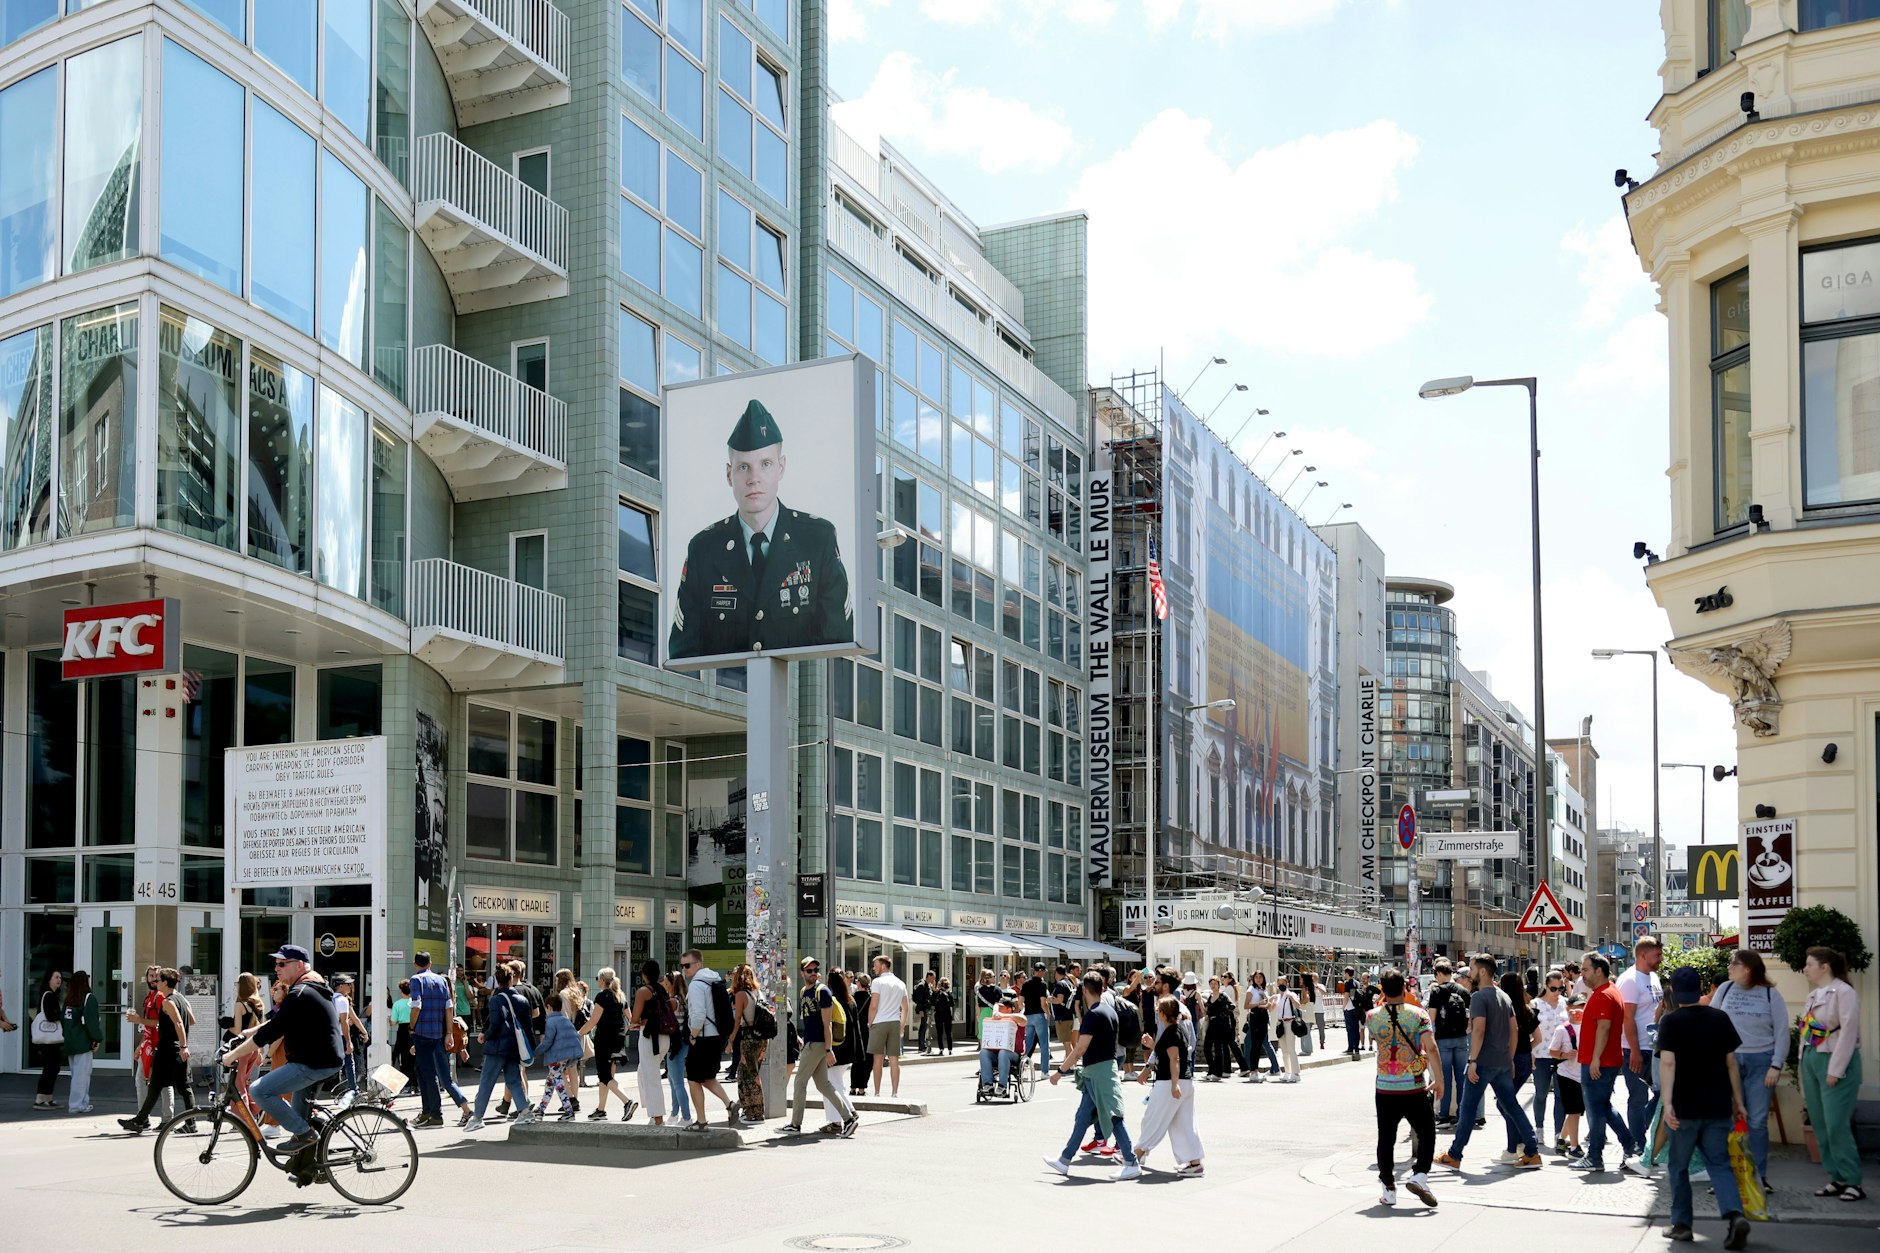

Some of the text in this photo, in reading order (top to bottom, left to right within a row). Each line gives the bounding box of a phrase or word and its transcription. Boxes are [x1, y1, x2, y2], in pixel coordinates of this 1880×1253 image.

[1728, 300, 1749, 318] GIG
[77, 317, 138, 361] CHARLI
[60, 615, 157, 662] KFC
[1090, 480, 1111, 880] MAUERMUSEUM THE WALL LE MUR
[1362, 680, 1374, 744] CHARLIE
[246, 744, 365, 761] YOU ARE ENTERING THE AMERICAN SECTOR
[246, 756, 364, 772] CARRYING WEAPONS OFF DUTY FORBIDDEN
[276, 769, 334, 782] OBEY TRAFFIC RULES
[243, 830, 257, 838] VOUS
[261, 828, 279, 838] ENTREZ
[283, 827, 296, 836] DANS
[299, 827, 304, 835] LE
[308, 826, 331, 835] SECTEUR
[1746, 823, 1792, 835] EINSTEIN
[263, 840, 268, 848] DE
[269, 839, 285, 848] PORTER
[296, 837, 310, 846] ARMES
[312, 837, 317, 845] EN
[319, 836, 337, 845] DEHORS
[339, 836, 345, 844] DU
[347, 834, 366, 843] SERVICE
[1438, 839, 1504, 852] Zimmerstraße
[249, 850, 274, 860] OBEISSEZ
[278, 849, 289, 858] AUX
[314, 848, 320, 856] DE
[323, 846, 358, 856] CIRCULATION
[254, 867, 278, 877] BETRETEN
[281, 866, 291, 876] DEN
[294, 864, 340, 876] AMERIKANISCHEN
[344, 863, 365, 874] SEKTOR
[1362, 855, 1374, 880] AM
[158, 882, 176, 898] 45
[472, 896, 549, 912] CHECKPOINT CHARLIE
[1749, 896, 1792, 906] KAFFEE
[836, 904, 878, 918] ECKPOINT CHARLIE
[904, 911, 932, 921] WALL MUSEUM
[1178, 910, 1188, 920] US
[1191, 909, 1209, 920] ARMY
[960, 915, 986, 926] MAUERMUSEUM
[1005, 919, 1038, 930] CHECKPOINT CHARLIE
[1050, 922, 1079, 933] CHECKPOINT CHARLIE
[693, 928, 716, 936] MAUER
